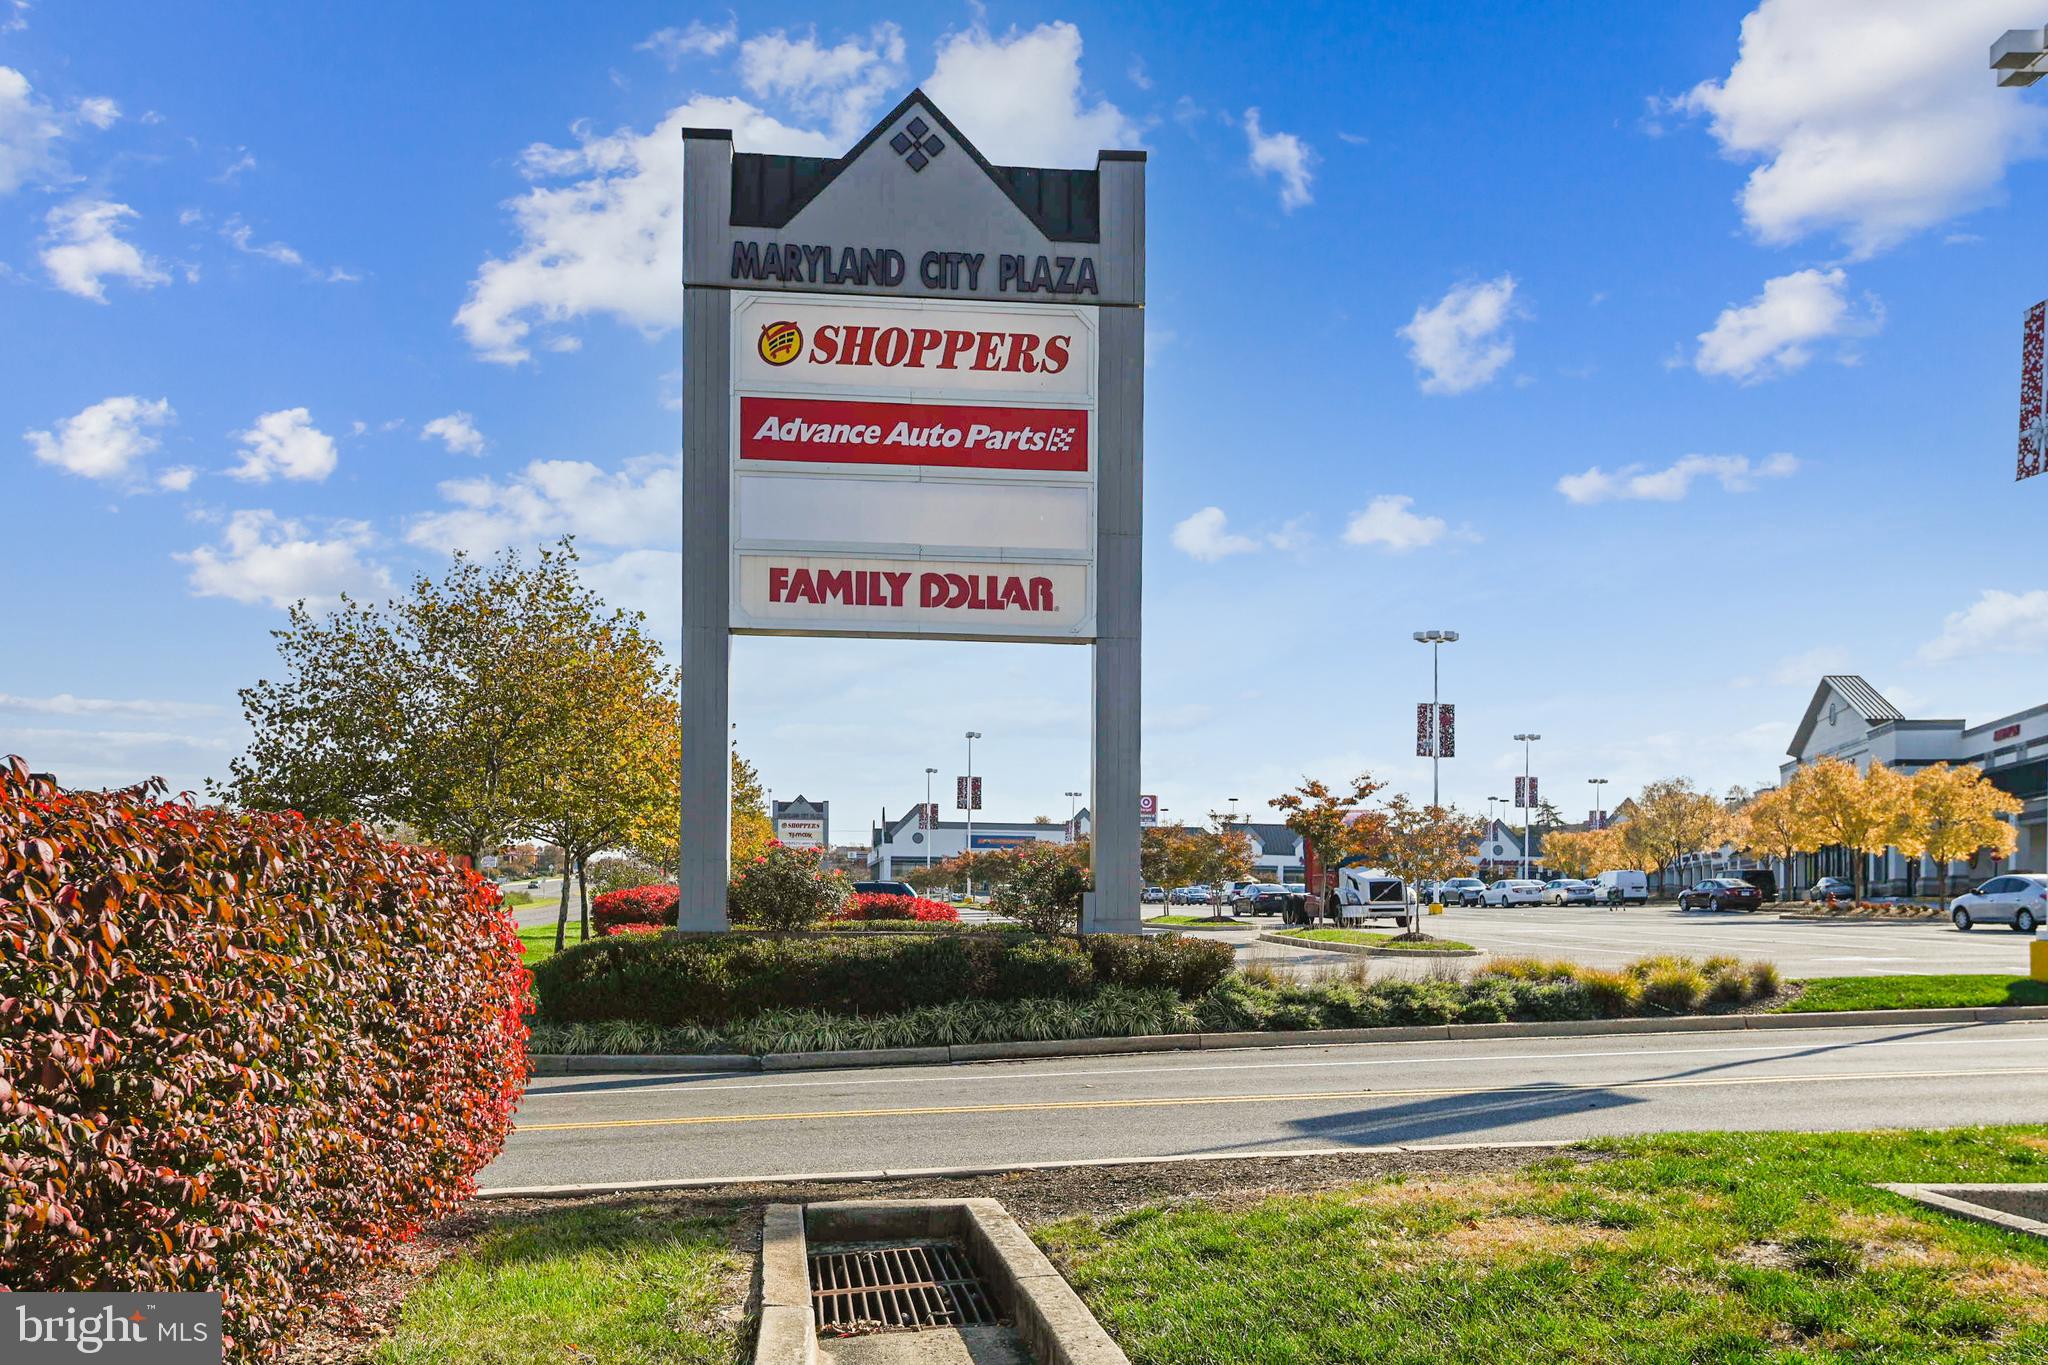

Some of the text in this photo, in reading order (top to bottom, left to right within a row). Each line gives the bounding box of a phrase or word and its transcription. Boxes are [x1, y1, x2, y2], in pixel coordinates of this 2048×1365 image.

[731, 241, 1099, 295] MARYLAND CITY PLAZA
[808, 325, 1071, 374] SHOPPERS
[753, 416, 1045, 451] Advance Auto Parts
[769, 567, 912, 607] FAMILY
